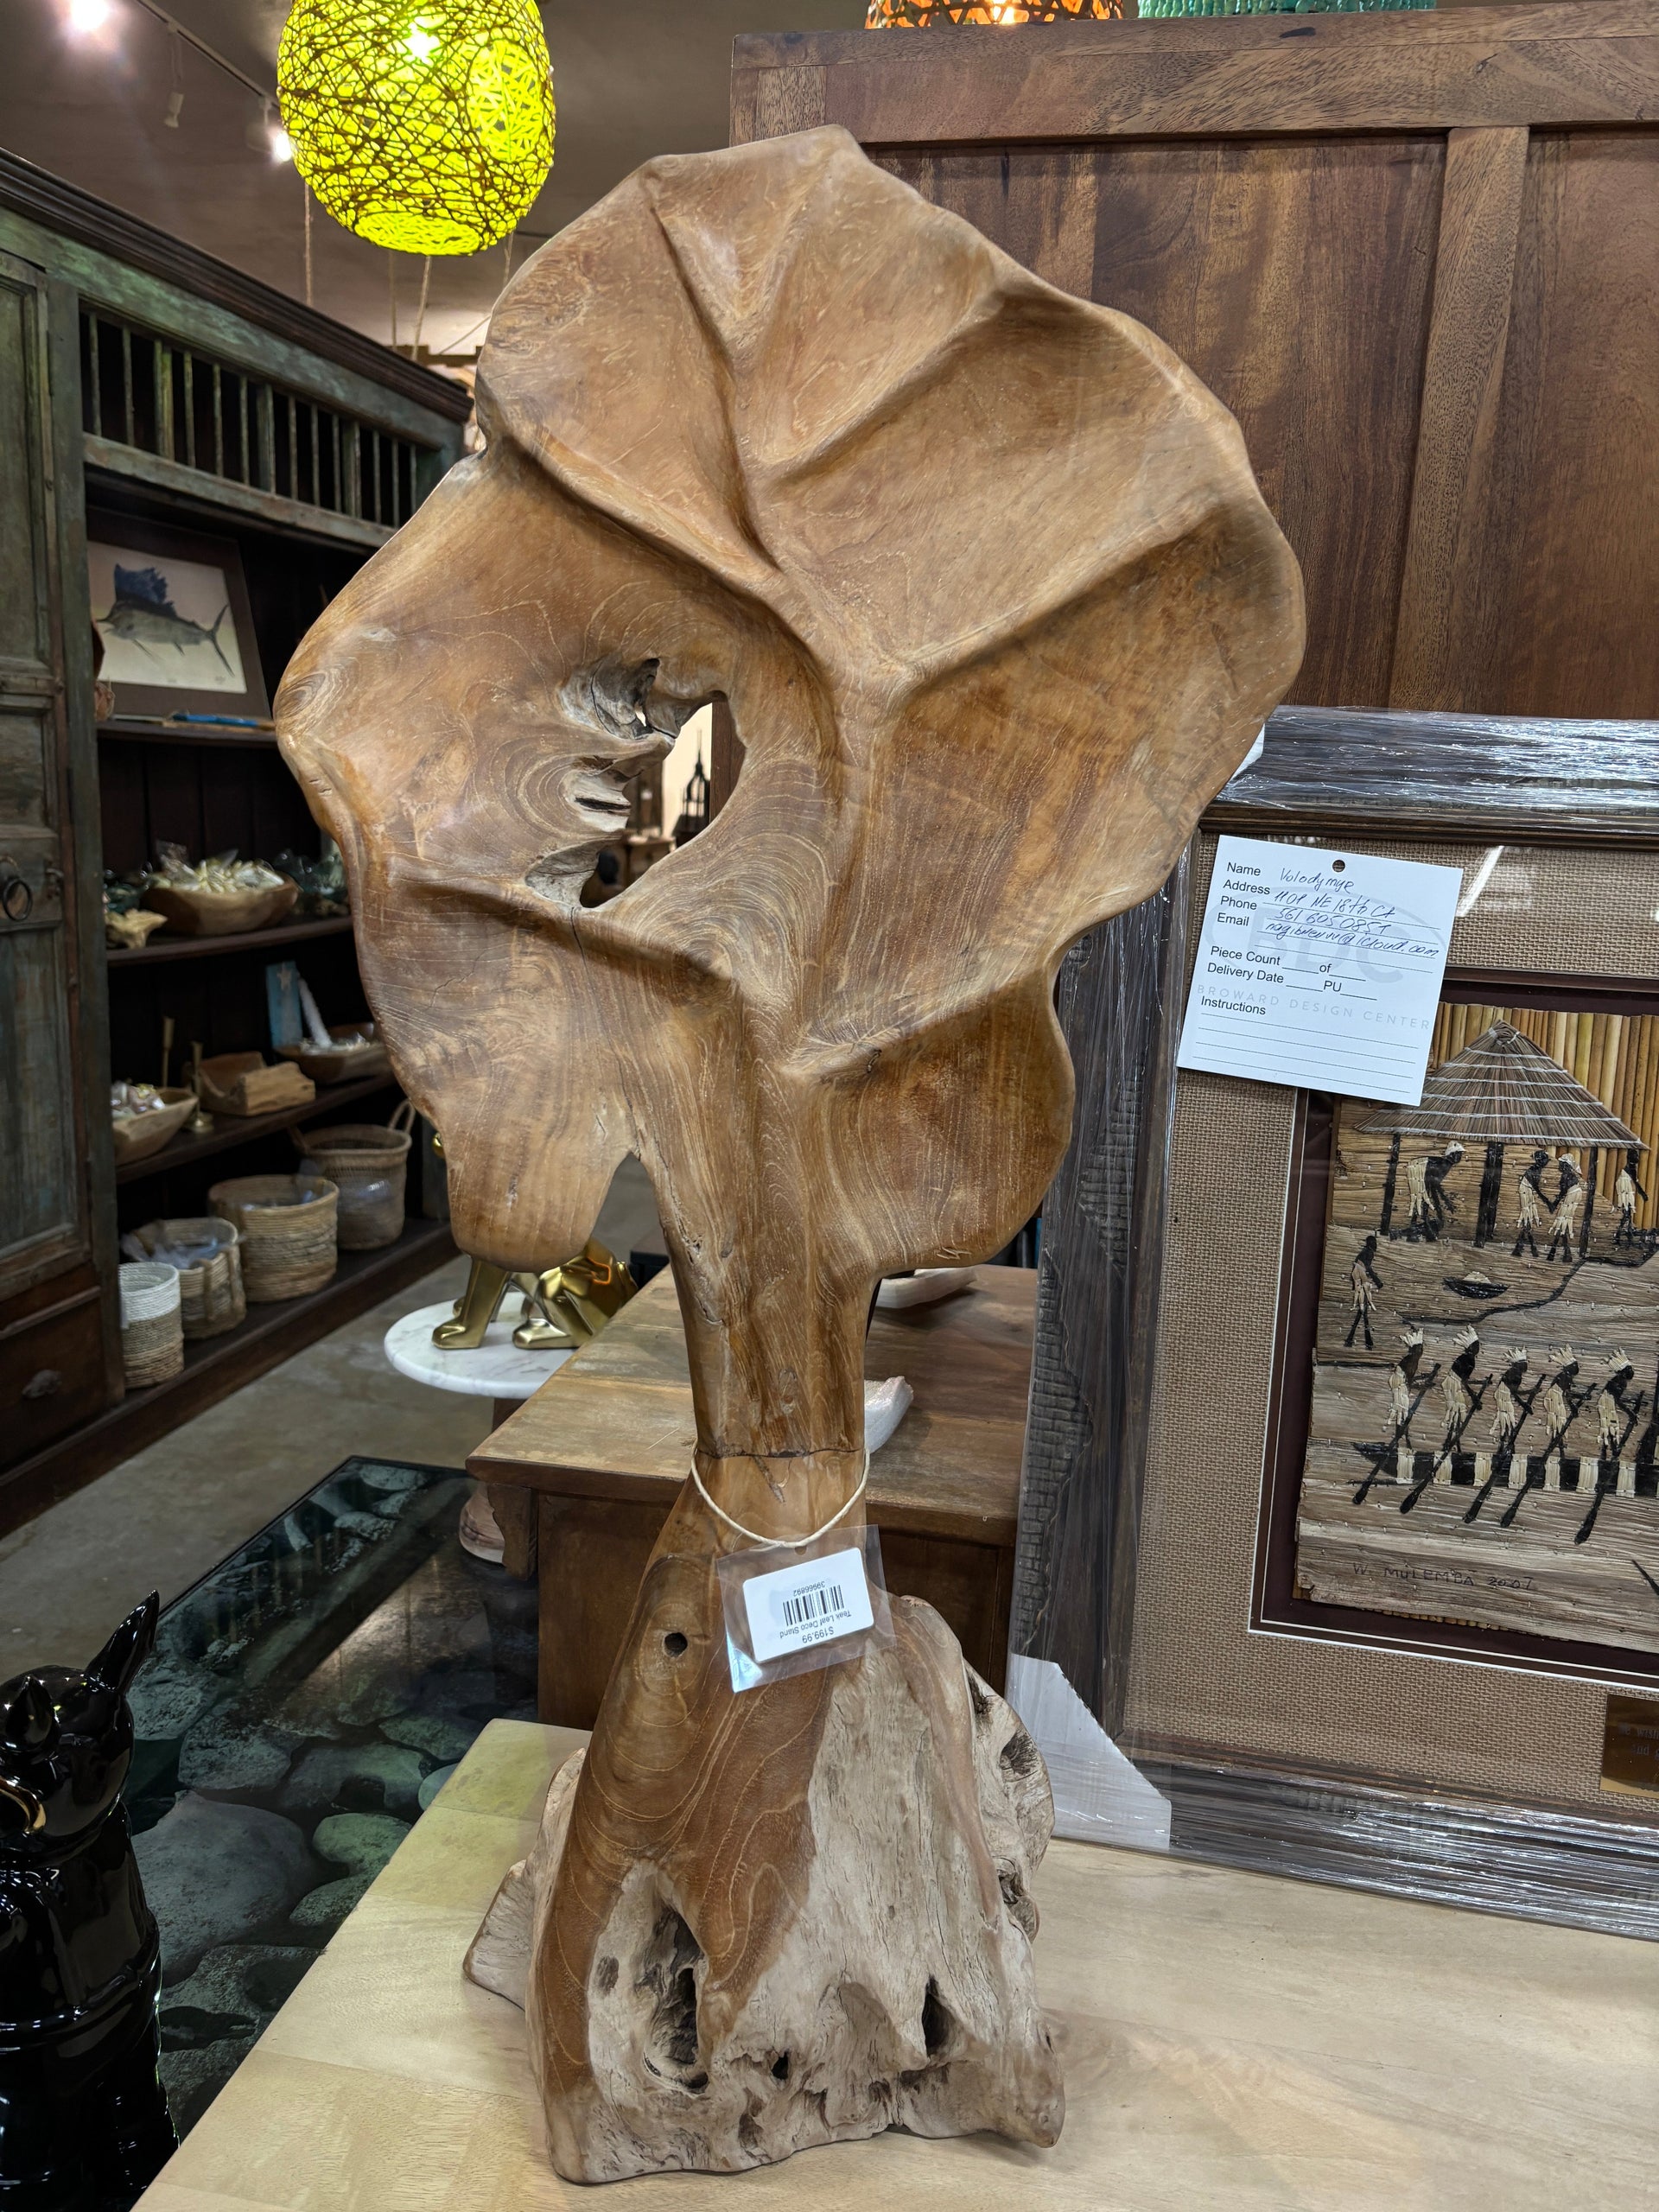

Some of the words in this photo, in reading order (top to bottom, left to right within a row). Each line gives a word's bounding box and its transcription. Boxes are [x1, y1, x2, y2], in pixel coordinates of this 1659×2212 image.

[1227, 861, 1262, 876] Name
[1223, 879, 1271, 895] Address
[1220, 895, 1257, 910] Phone
[1311, 893, 1332, 908] NE
[1217, 912, 1249, 926] Email
[1274, 907, 1299, 921] 561
[1306, 912, 1338, 929] 605
[1211, 946, 1243, 960] Piece
[1246, 951, 1281, 966] Count
[1319, 963, 1332, 973] of
[1207, 963, 1254, 981] Delivery
[1256, 970, 1284, 983] Date
[1323, 981, 1342, 992] PU
[1198, 984, 1280, 1005] BROWARD
[1289, 999, 1353, 1017] DESIGN
[1363, 1011, 1430, 1030] CENTER
[1201, 995, 1266, 1014] Instructions
[820, 1614, 835, 1625] Leaf
[836, 1610, 852, 1619] Teak
[779, 1626, 799, 1638] Stand
[801, 1620, 819, 1630] Deco
[802, 1626, 835, 1643] $199.99
